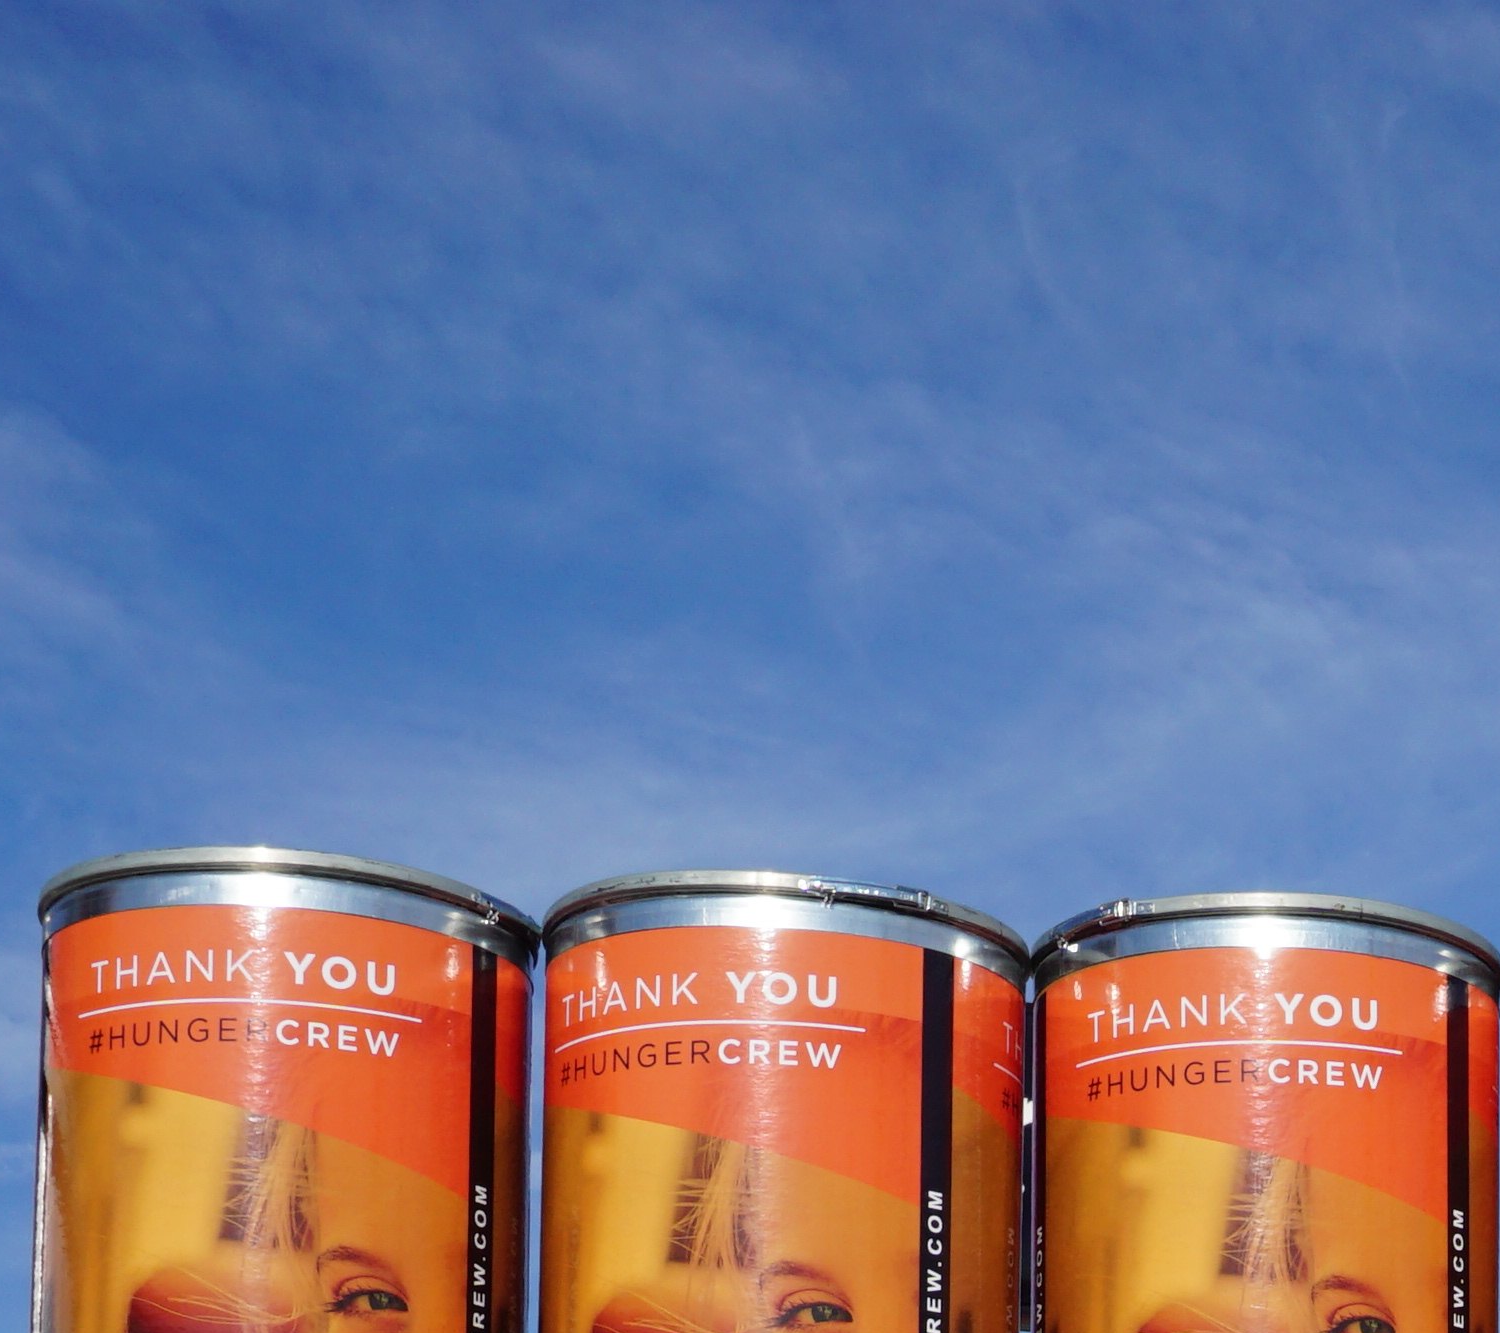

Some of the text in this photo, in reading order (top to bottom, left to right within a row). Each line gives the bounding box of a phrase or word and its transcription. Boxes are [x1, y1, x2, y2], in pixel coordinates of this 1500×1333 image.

[91, 950, 395, 996] THANK YOU
[561, 970, 837, 1028] THANK YOU
[1088, 993, 1378, 1044] THANK YOU
[89, 1017, 400, 1058] #HUNGERCREW
[560, 1038, 842, 1086] #HUNGERCREW
[1087, 1058, 1383, 1101] #HUNGERCREW
